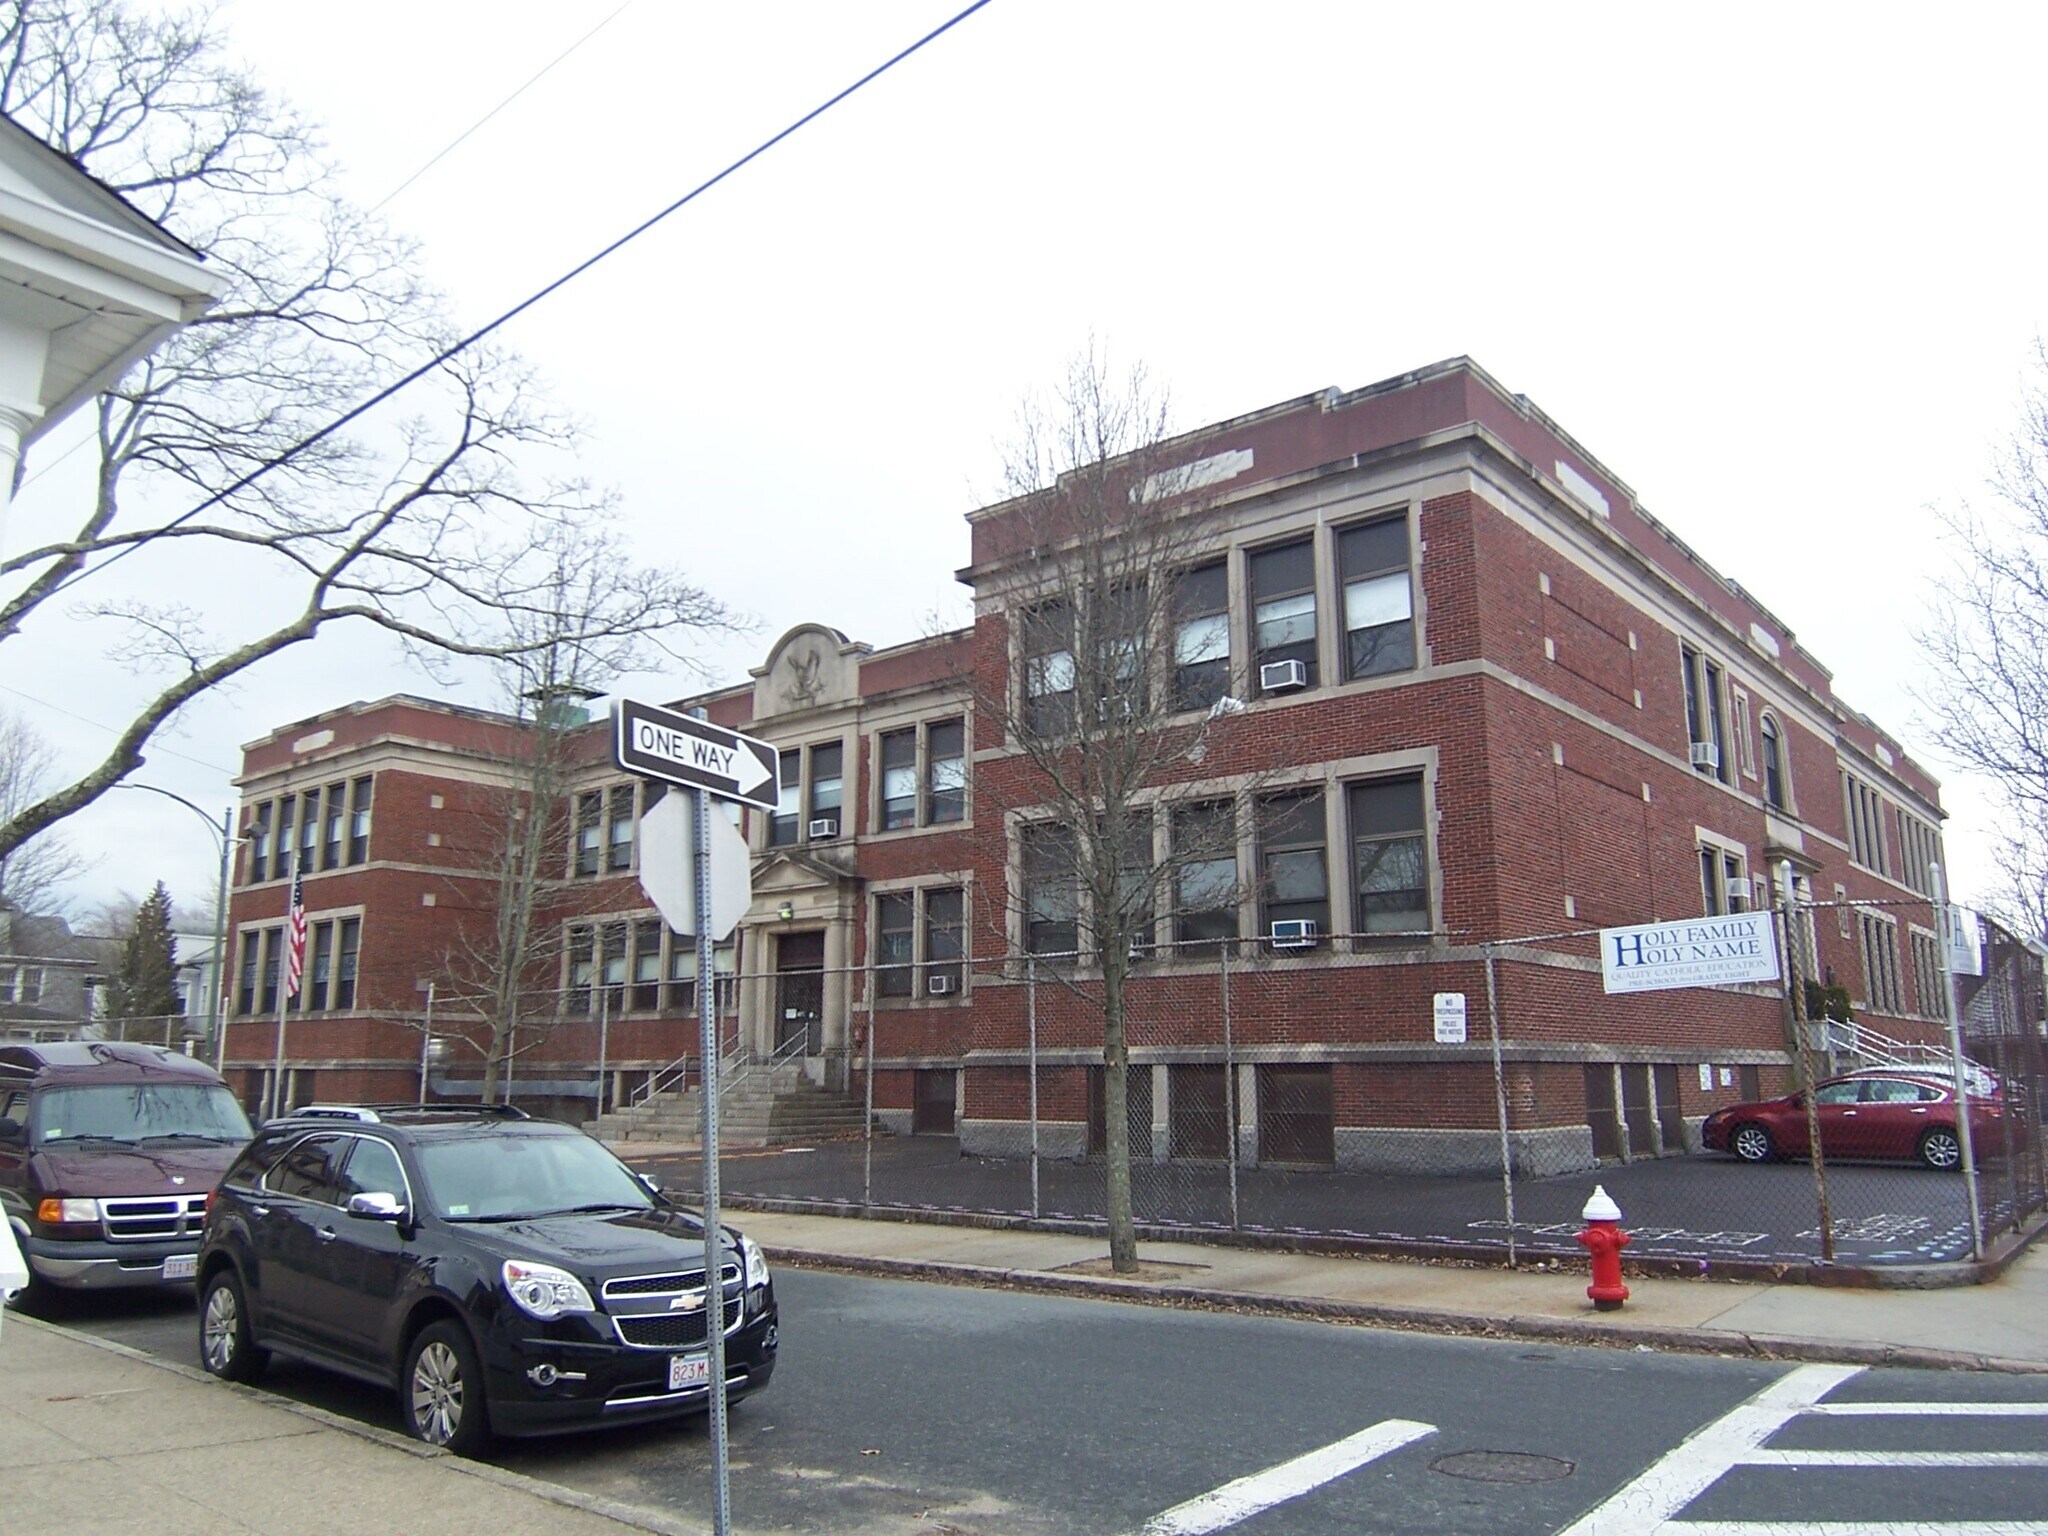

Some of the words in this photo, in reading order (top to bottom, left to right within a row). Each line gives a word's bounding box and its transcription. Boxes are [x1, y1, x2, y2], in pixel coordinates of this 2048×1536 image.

[640, 725, 684, 760] ONE
[692, 740, 734, 774] WAY
[1687, 920, 1757, 942] FAMILY
[1692, 939, 1761, 960] NAME
[1611, 969, 1651, 982] QUALITY
[1654, 965, 1703, 977] CATHOLIC
[1707, 959, 1767, 972] EDUCATION
[673, 1362, 695, 1382] 823
